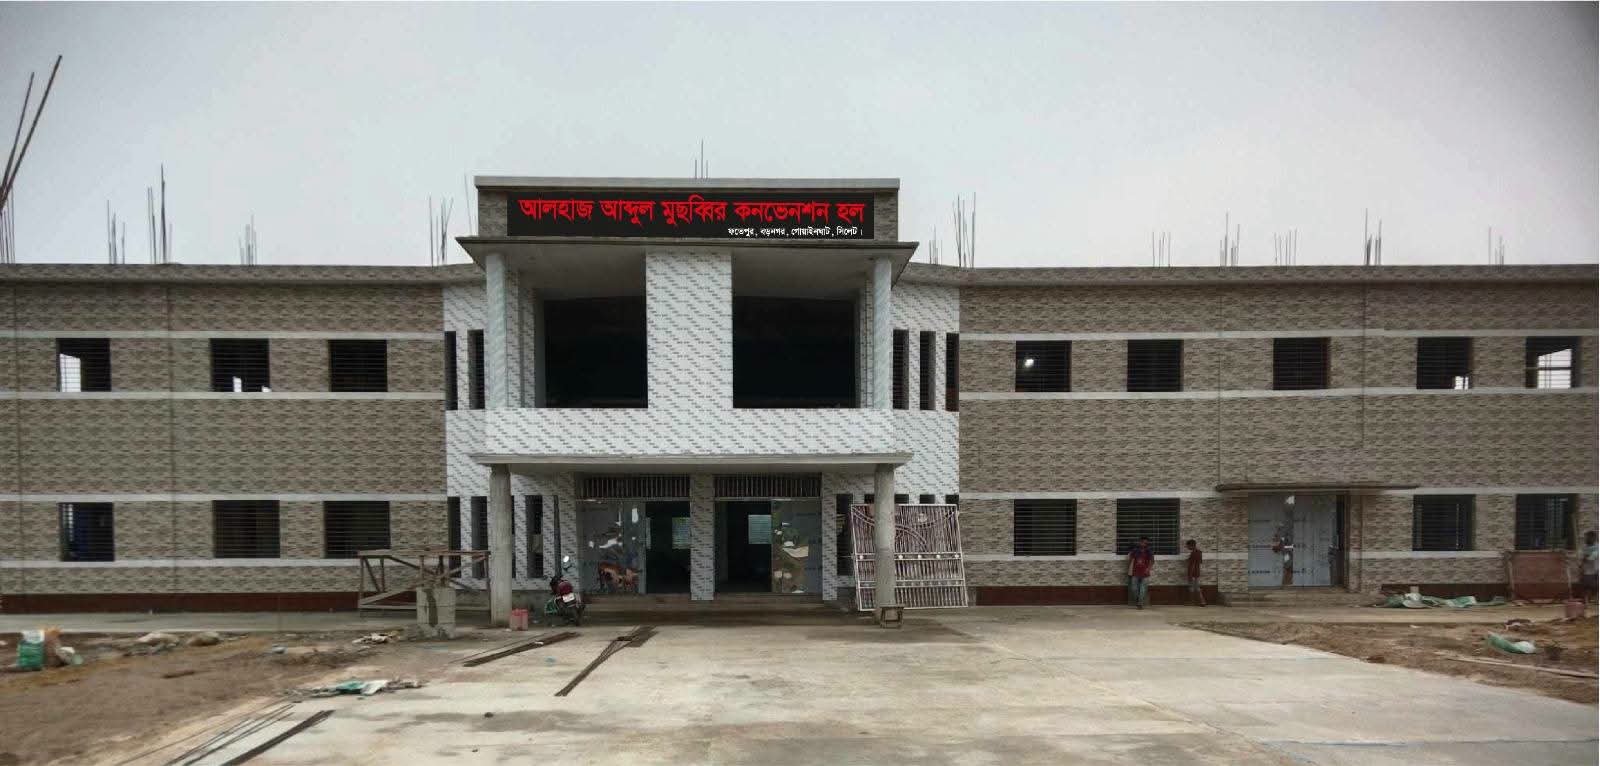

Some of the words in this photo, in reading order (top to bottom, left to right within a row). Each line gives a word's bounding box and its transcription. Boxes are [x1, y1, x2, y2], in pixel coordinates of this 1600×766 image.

[517, 198, 594, 222] আলহাজ
[733, 201, 831, 224] কনভেনশন
[835, 202, 866, 224] হল
